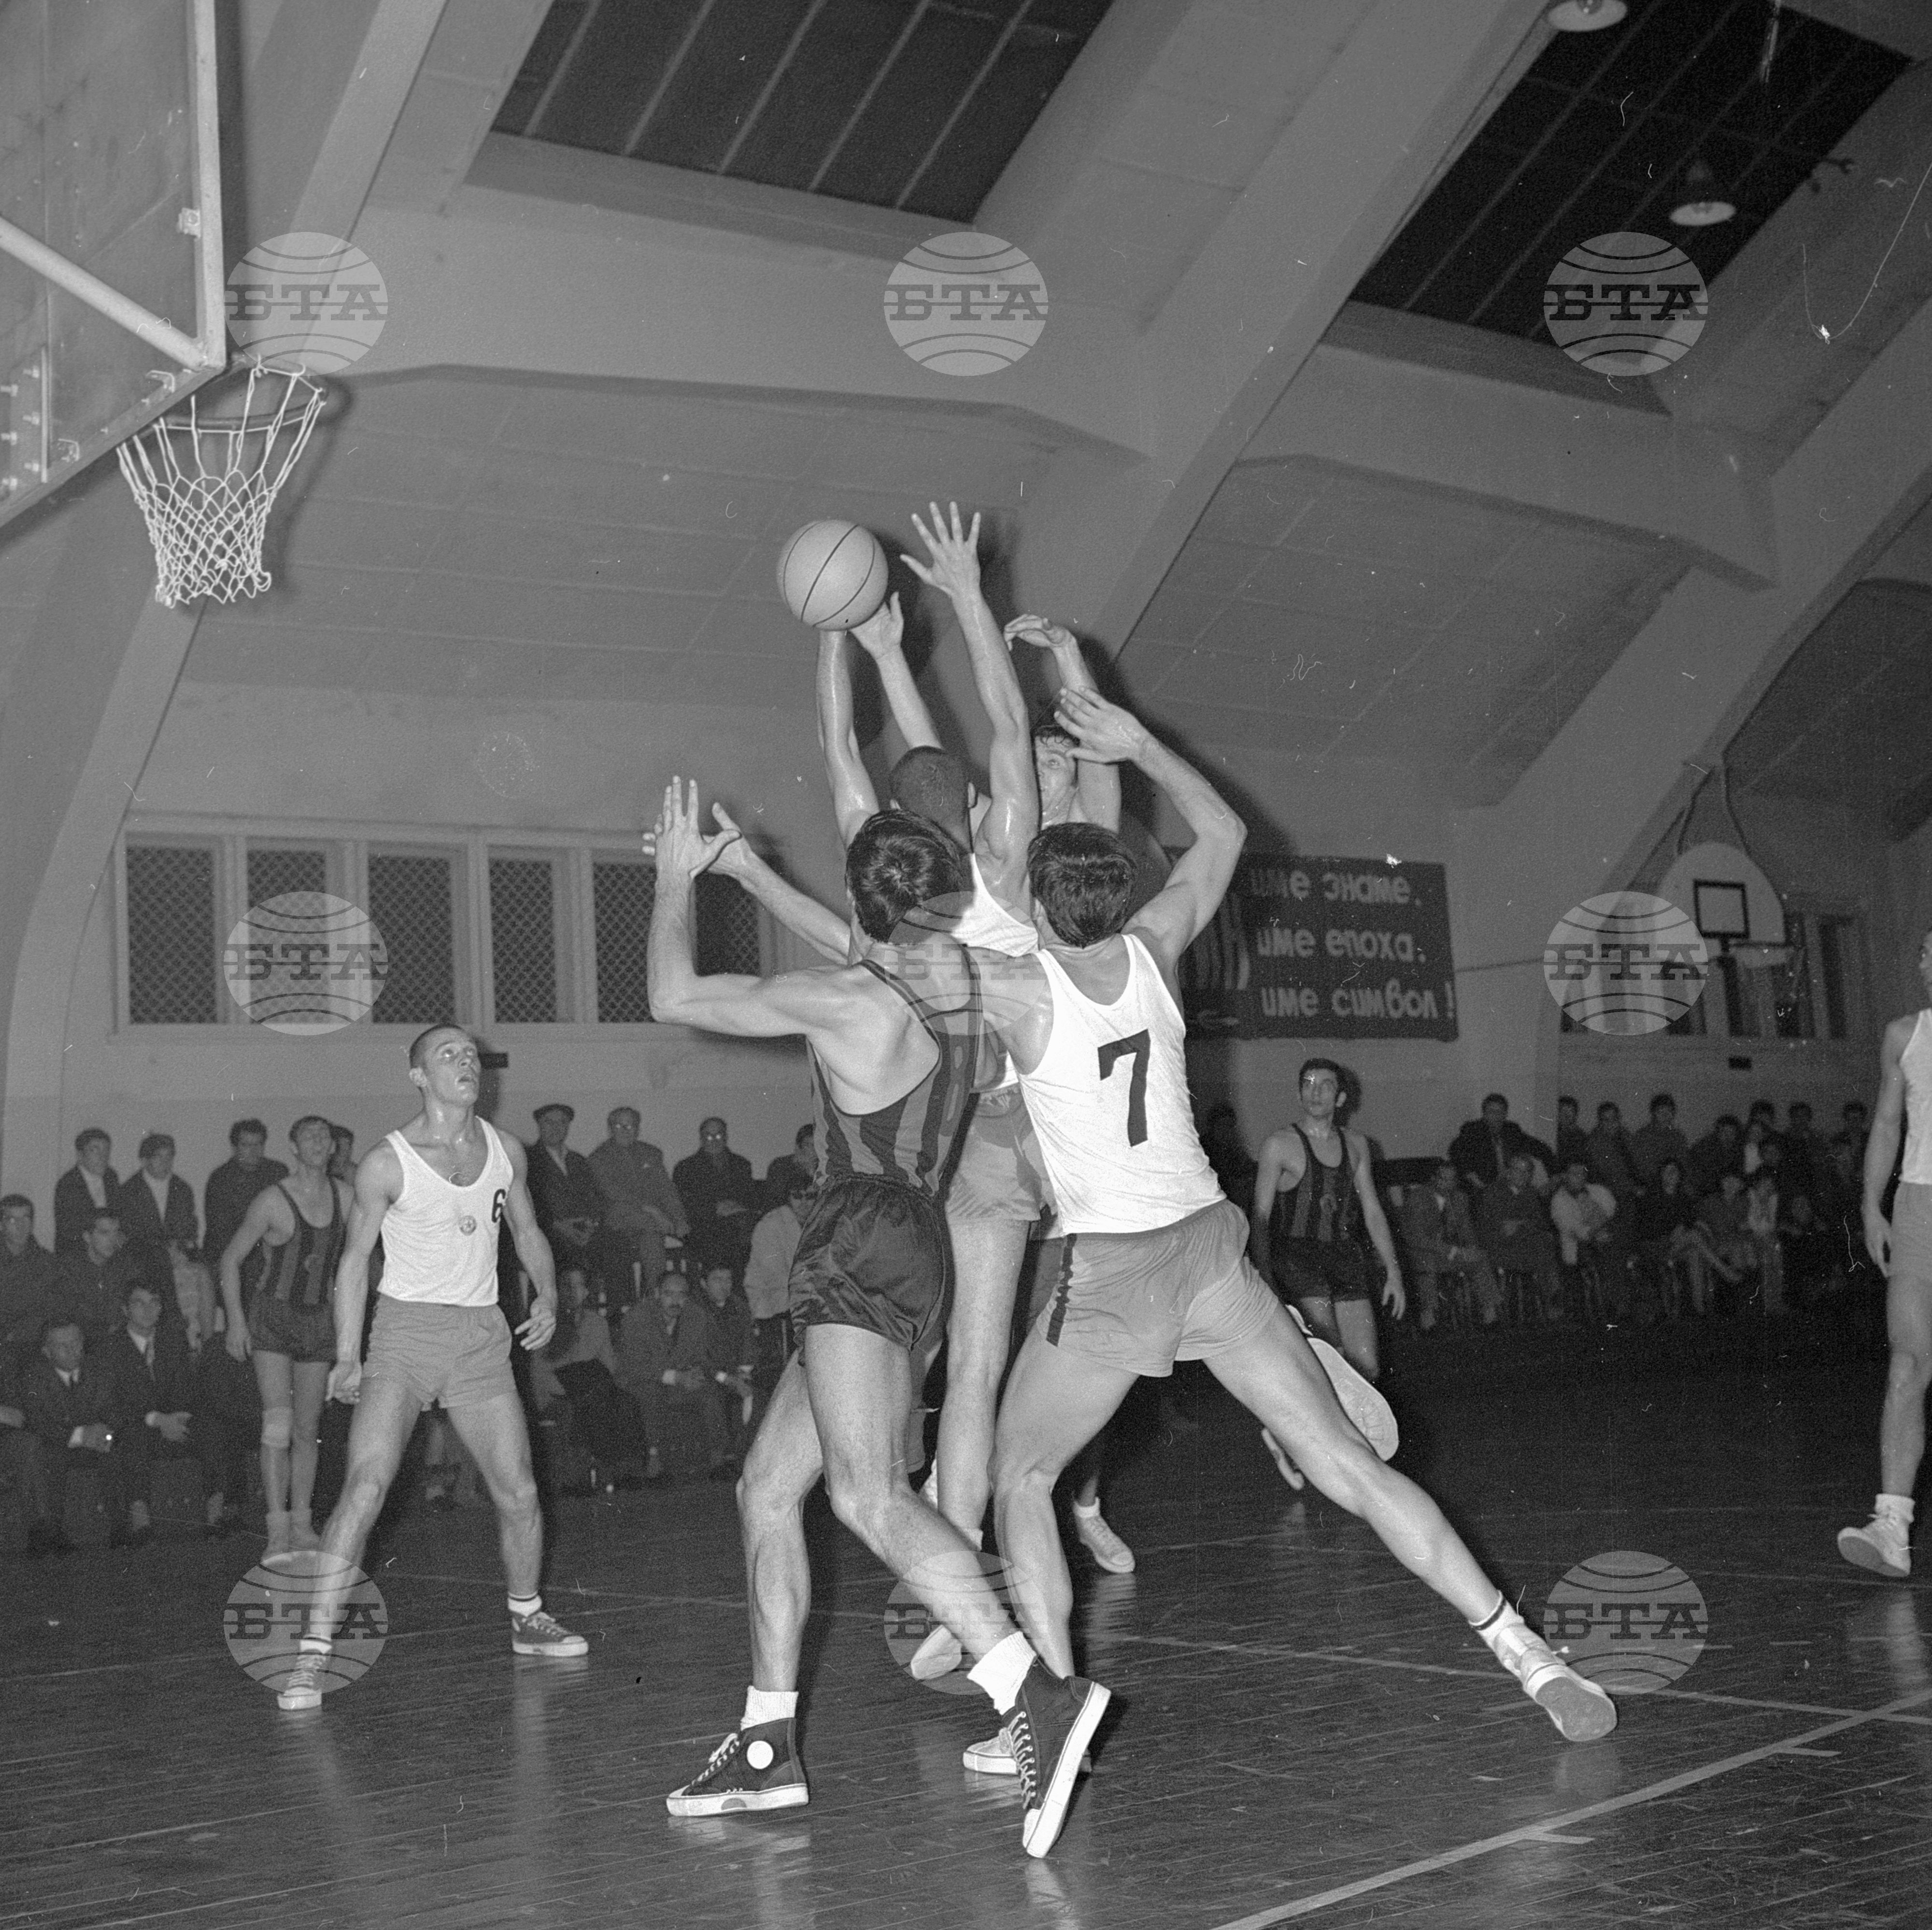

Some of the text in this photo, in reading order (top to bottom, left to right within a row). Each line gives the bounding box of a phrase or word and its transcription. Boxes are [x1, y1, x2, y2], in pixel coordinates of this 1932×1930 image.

[1322, 872, 1421, 907] знаме.
[1256, 927, 1426, 963] име епоха.
[1261, 986, 1319, 1017] име
[1097, 1029, 1151, 1147] 7
[491, 1188, 507, 1224] 6
